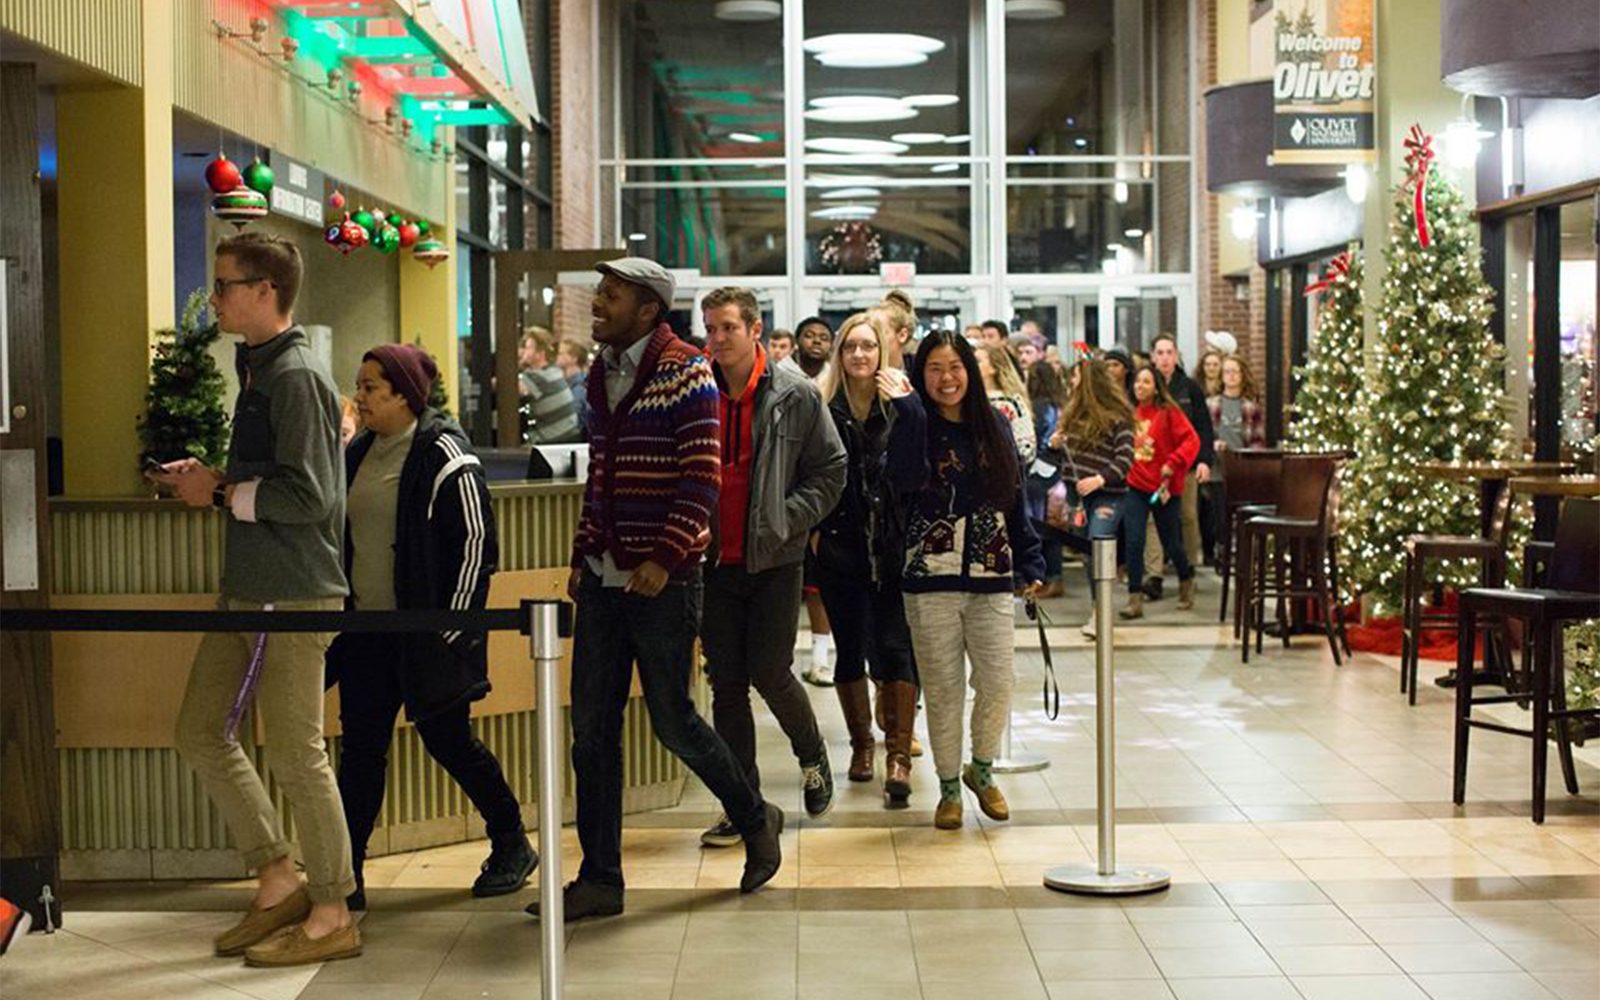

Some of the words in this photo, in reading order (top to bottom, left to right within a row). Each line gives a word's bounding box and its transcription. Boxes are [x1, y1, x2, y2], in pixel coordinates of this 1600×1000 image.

[1278, 34, 1361, 51] Welcome
[1338, 53, 1358, 69] to
[1274, 62, 1374, 98] Olivet
[1310, 118, 1356, 129] OLIVET
